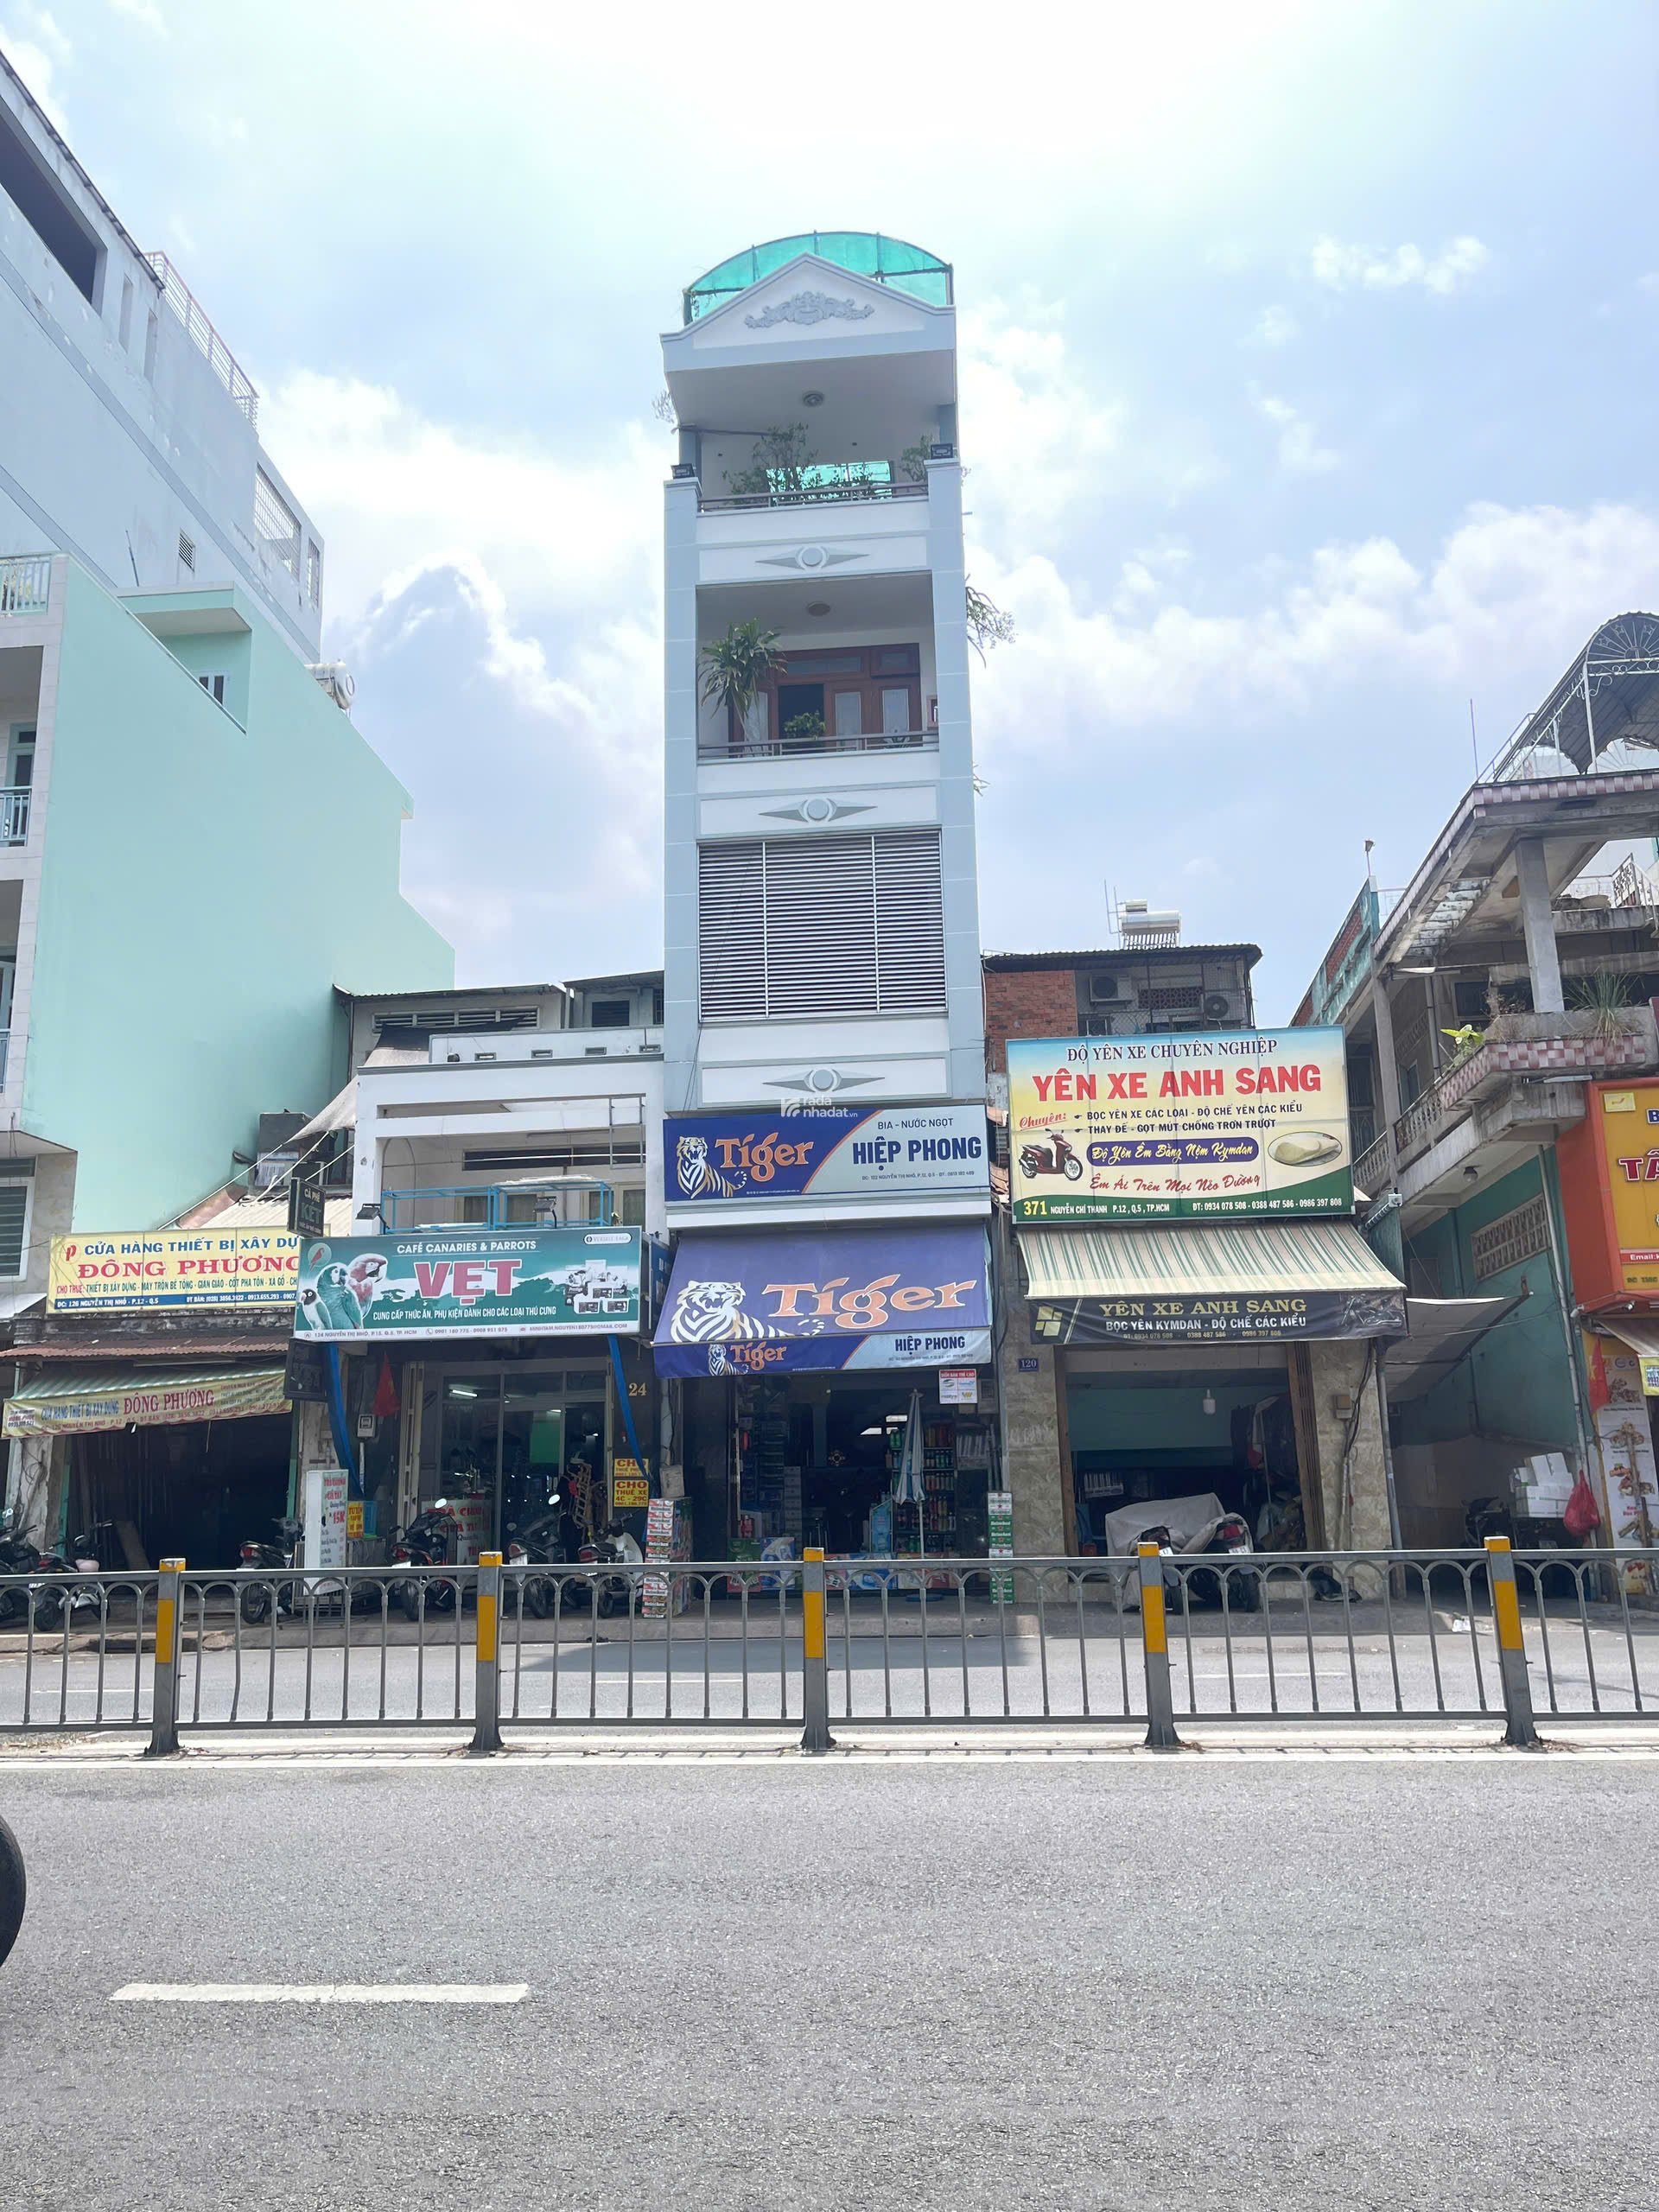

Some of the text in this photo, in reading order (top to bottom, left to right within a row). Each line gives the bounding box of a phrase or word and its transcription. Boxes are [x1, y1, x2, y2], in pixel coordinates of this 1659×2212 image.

[1068, 1037, 1277, 1064] ĐỘ YÊN XE CHUYÊN NGHIỆP
[1032, 1064, 1321, 1102] YÊN XE ANH SANG
[1020, 1113, 1066, 1128] Chuyên:
[1087, 1111, 1106, 1122] BỌC
[1109, 1109, 1127, 1119] YÊN
[1145, 1108, 1163, 1118] CÁC
[1167, 1109, 1188, 1117] LOẠI
[1198, 1106, 1210, 1117] ĐỘ
[1213, 1103, 1233, 1115] CHẾ
[1236, 1104, 1255, 1114] YÊN
[1258, 1103, 1276, 1114] CÁC
[1280, 1100, 1302, 1112] KIỂU
[902, 1118, 926, 1128] NƯỚC
[929, 1118, 953, 1128] NGỌT
[1137, 1124, 1155, 1134] GỌT
[1159, 1122, 1179, 1132] MÚT
[1183, 1119, 1214, 1131] CHỐNG
[1217, 1120, 1242, 1129] TRƠN
[1245, 1119, 1275, 1129] TRƯỢT
[715, 1132, 814, 1182] Tiger
[853, 1136, 982, 1171] HIỆP PHONG
[1092, 1142, 1253, 1165] Độ Yên Êm Bằng Nệm Kymdan
[1090, 1173, 1109, 1190] Êm
[1114, 1175, 1128, 1190] Ái
[1134, 1179, 1160, 1192] Trên
[1166, 1179, 1192, 1193] Mọi
[1023, 1200, 1047, 1216] 371
[1051, 1202, 1074, 1214] NGUYỄN
[1076, 1204, 1086, 1213] CHÍ
[1087, 1205, 1107, 1213] THANH
[1146, 1204, 1169, 1212] TP.HCM
[1235, 1201, 1246, 1210] 508
[1268, 1200, 1281, 1209] 487
[1300, 1199, 1315, 1208] 0986
[1317, 1198, 1328, 1207] 397
[85, 1236, 299, 1255] CỬA HÀNG THIẾT BỊ XÂY DỰ
[397, 1241, 537, 1254] CAFÉ CANARIES & PARROTS
[78, 1259, 166, 1279] ĐÔNG
[86, 1281, 101, 1293] THIẾT
[103, 1283, 109, 1294] BỊ
[111, 1281, 120, 1291] XÂY
[122, 1281, 137, 1291] DỰNG
[242, 1278, 251, 1287] PHA
[414, 1259, 522, 1306] VẸT
[763, 1274, 977, 1330] Tiger
[1099, 1300, 1307, 1317] YÊN XE ANH SANG
[373, 1312, 390, 1320] CUNG
[391, 1308, 404, 1320] CẤP
[405, 1307, 421, 1319] THỨC
[435, 1310, 447, 1319] PHỤ
[448, 1307, 462, 1319] KIỆN
[483, 1308, 495, 1317] CHO
[497, 1306, 509, 1317] CÁC
[511, 1307, 524, 1318] LOẠI
[526, 1306, 538, 1316] THÚ
[539, 1306, 556, 1315] CƯNG
[1106, 1313, 1306, 1332] BỌC YÊN KYMDAN ĐỘ CHẾ CÁC KIỂU
[895, 1335, 965, 1355] HIỆP PHONG
[730, 1341, 787, 1371] Tiger
[1021, 1359, 1037, 1368] 120
[628, 1382, 647, 1397] 24
[124, 1392, 159, 1414] ĐÔNG
[163, 1389, 214, 1411] PHƯƠNG
